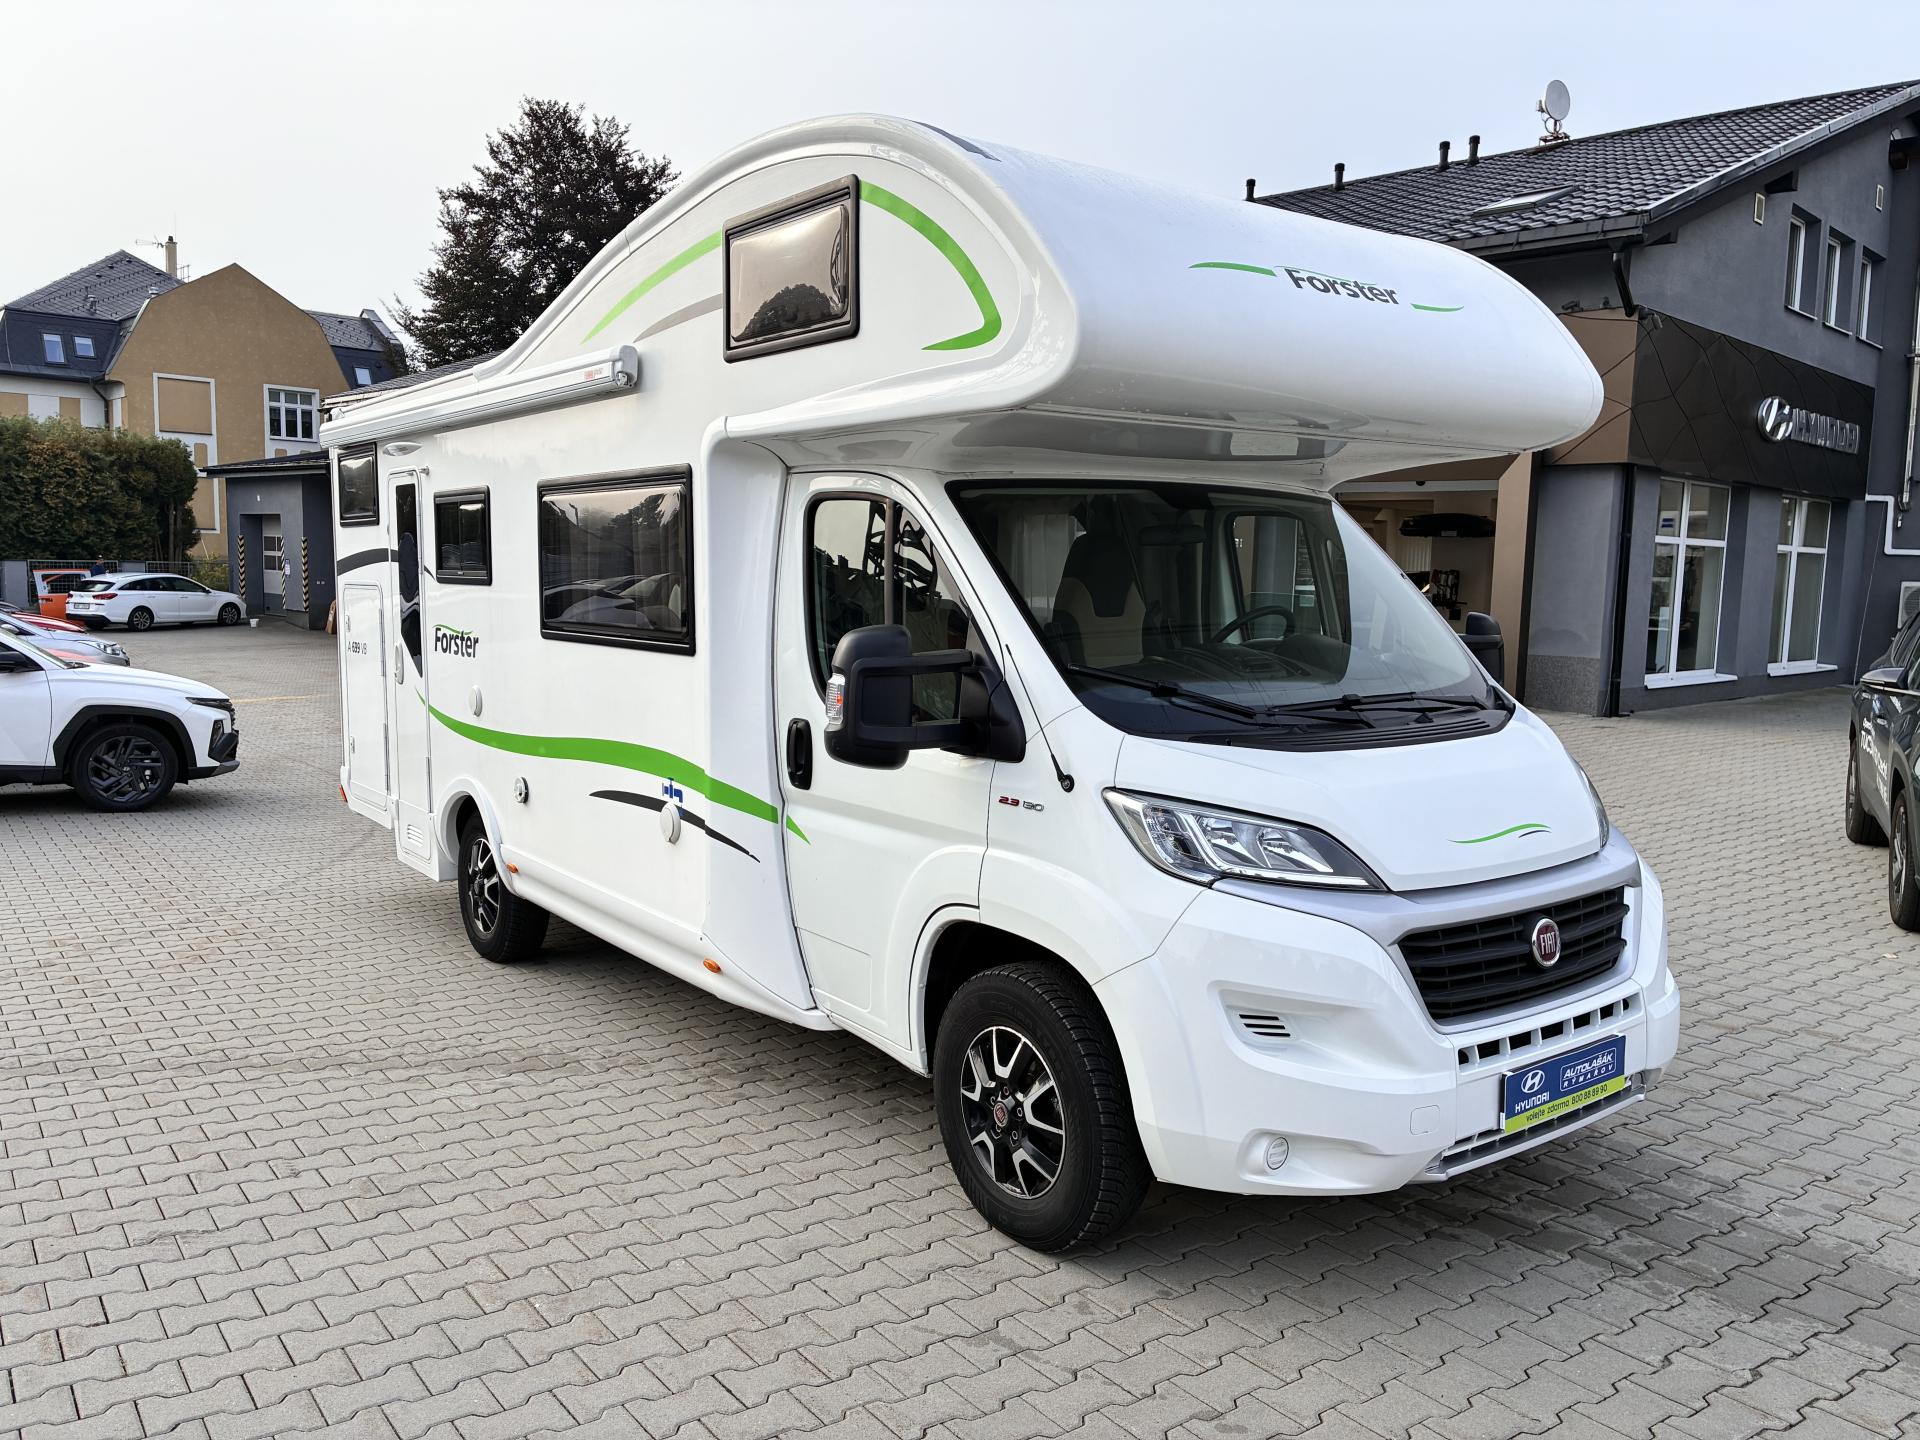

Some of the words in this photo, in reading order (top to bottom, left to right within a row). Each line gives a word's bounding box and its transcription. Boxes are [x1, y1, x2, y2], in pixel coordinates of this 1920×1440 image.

[1284, 267, 1400, 305] Forster
[434, 627, 479, 659] Forster
[1540, 931, 1556, 955] FIAT
[1563, 1052, 1614, 1079] AUTOLAŠÁK
[1514, 1091, 1550, 1113] HYUNDAI
